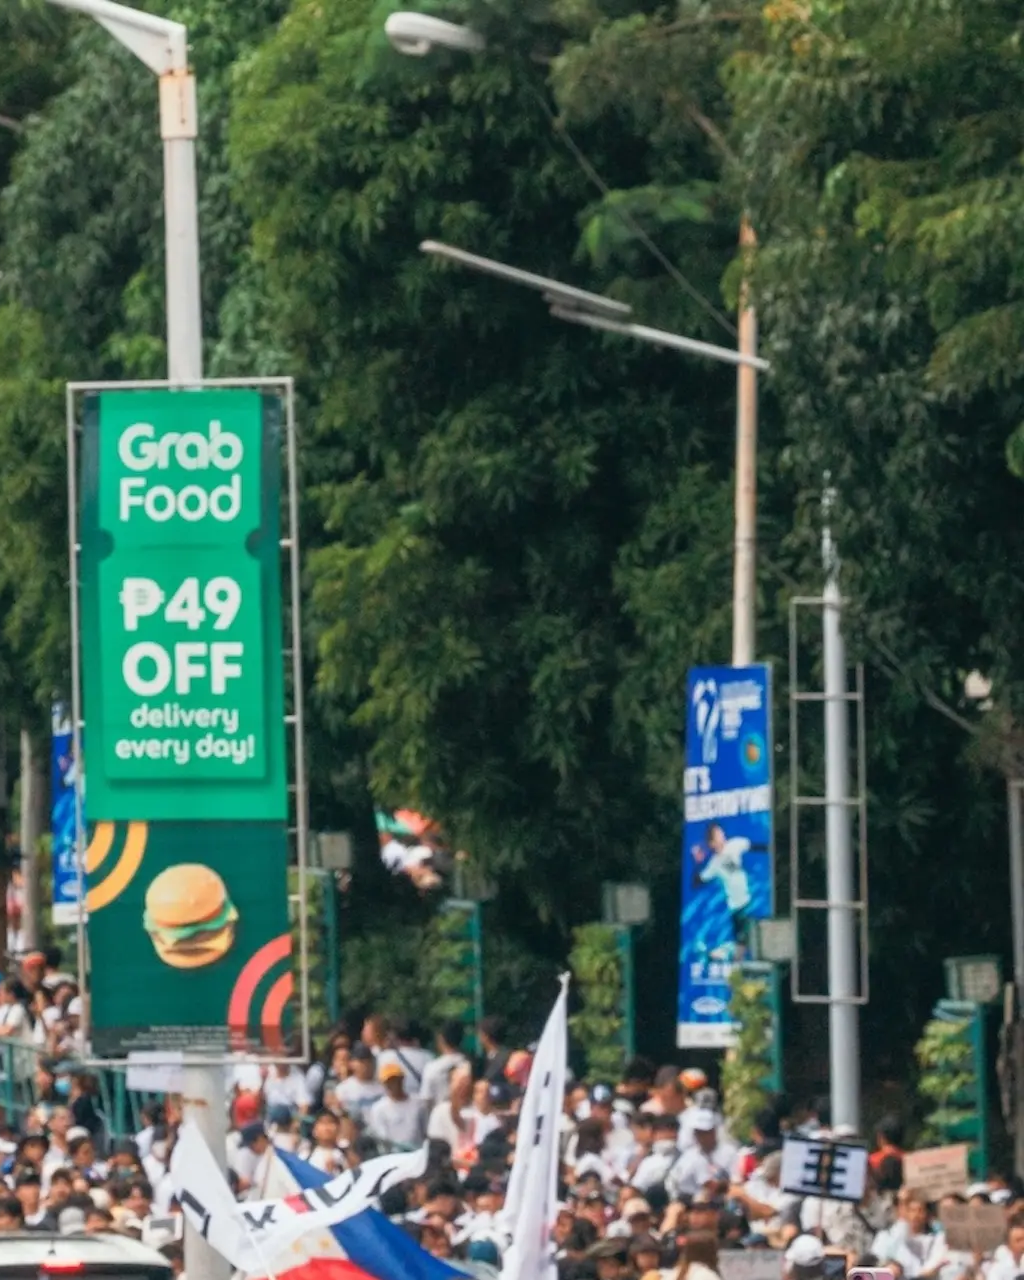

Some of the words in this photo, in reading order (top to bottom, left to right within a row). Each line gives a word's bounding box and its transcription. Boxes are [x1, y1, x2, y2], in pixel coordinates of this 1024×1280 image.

[118, 420, 244, 471] Grab
[119, 473, 242, 522] Food
[122, 641, 244, 696] OFF
[130, 703, 239, 734] delivery
[115, 737, 190, 764] every
[195, 734, 256, 765] day!
